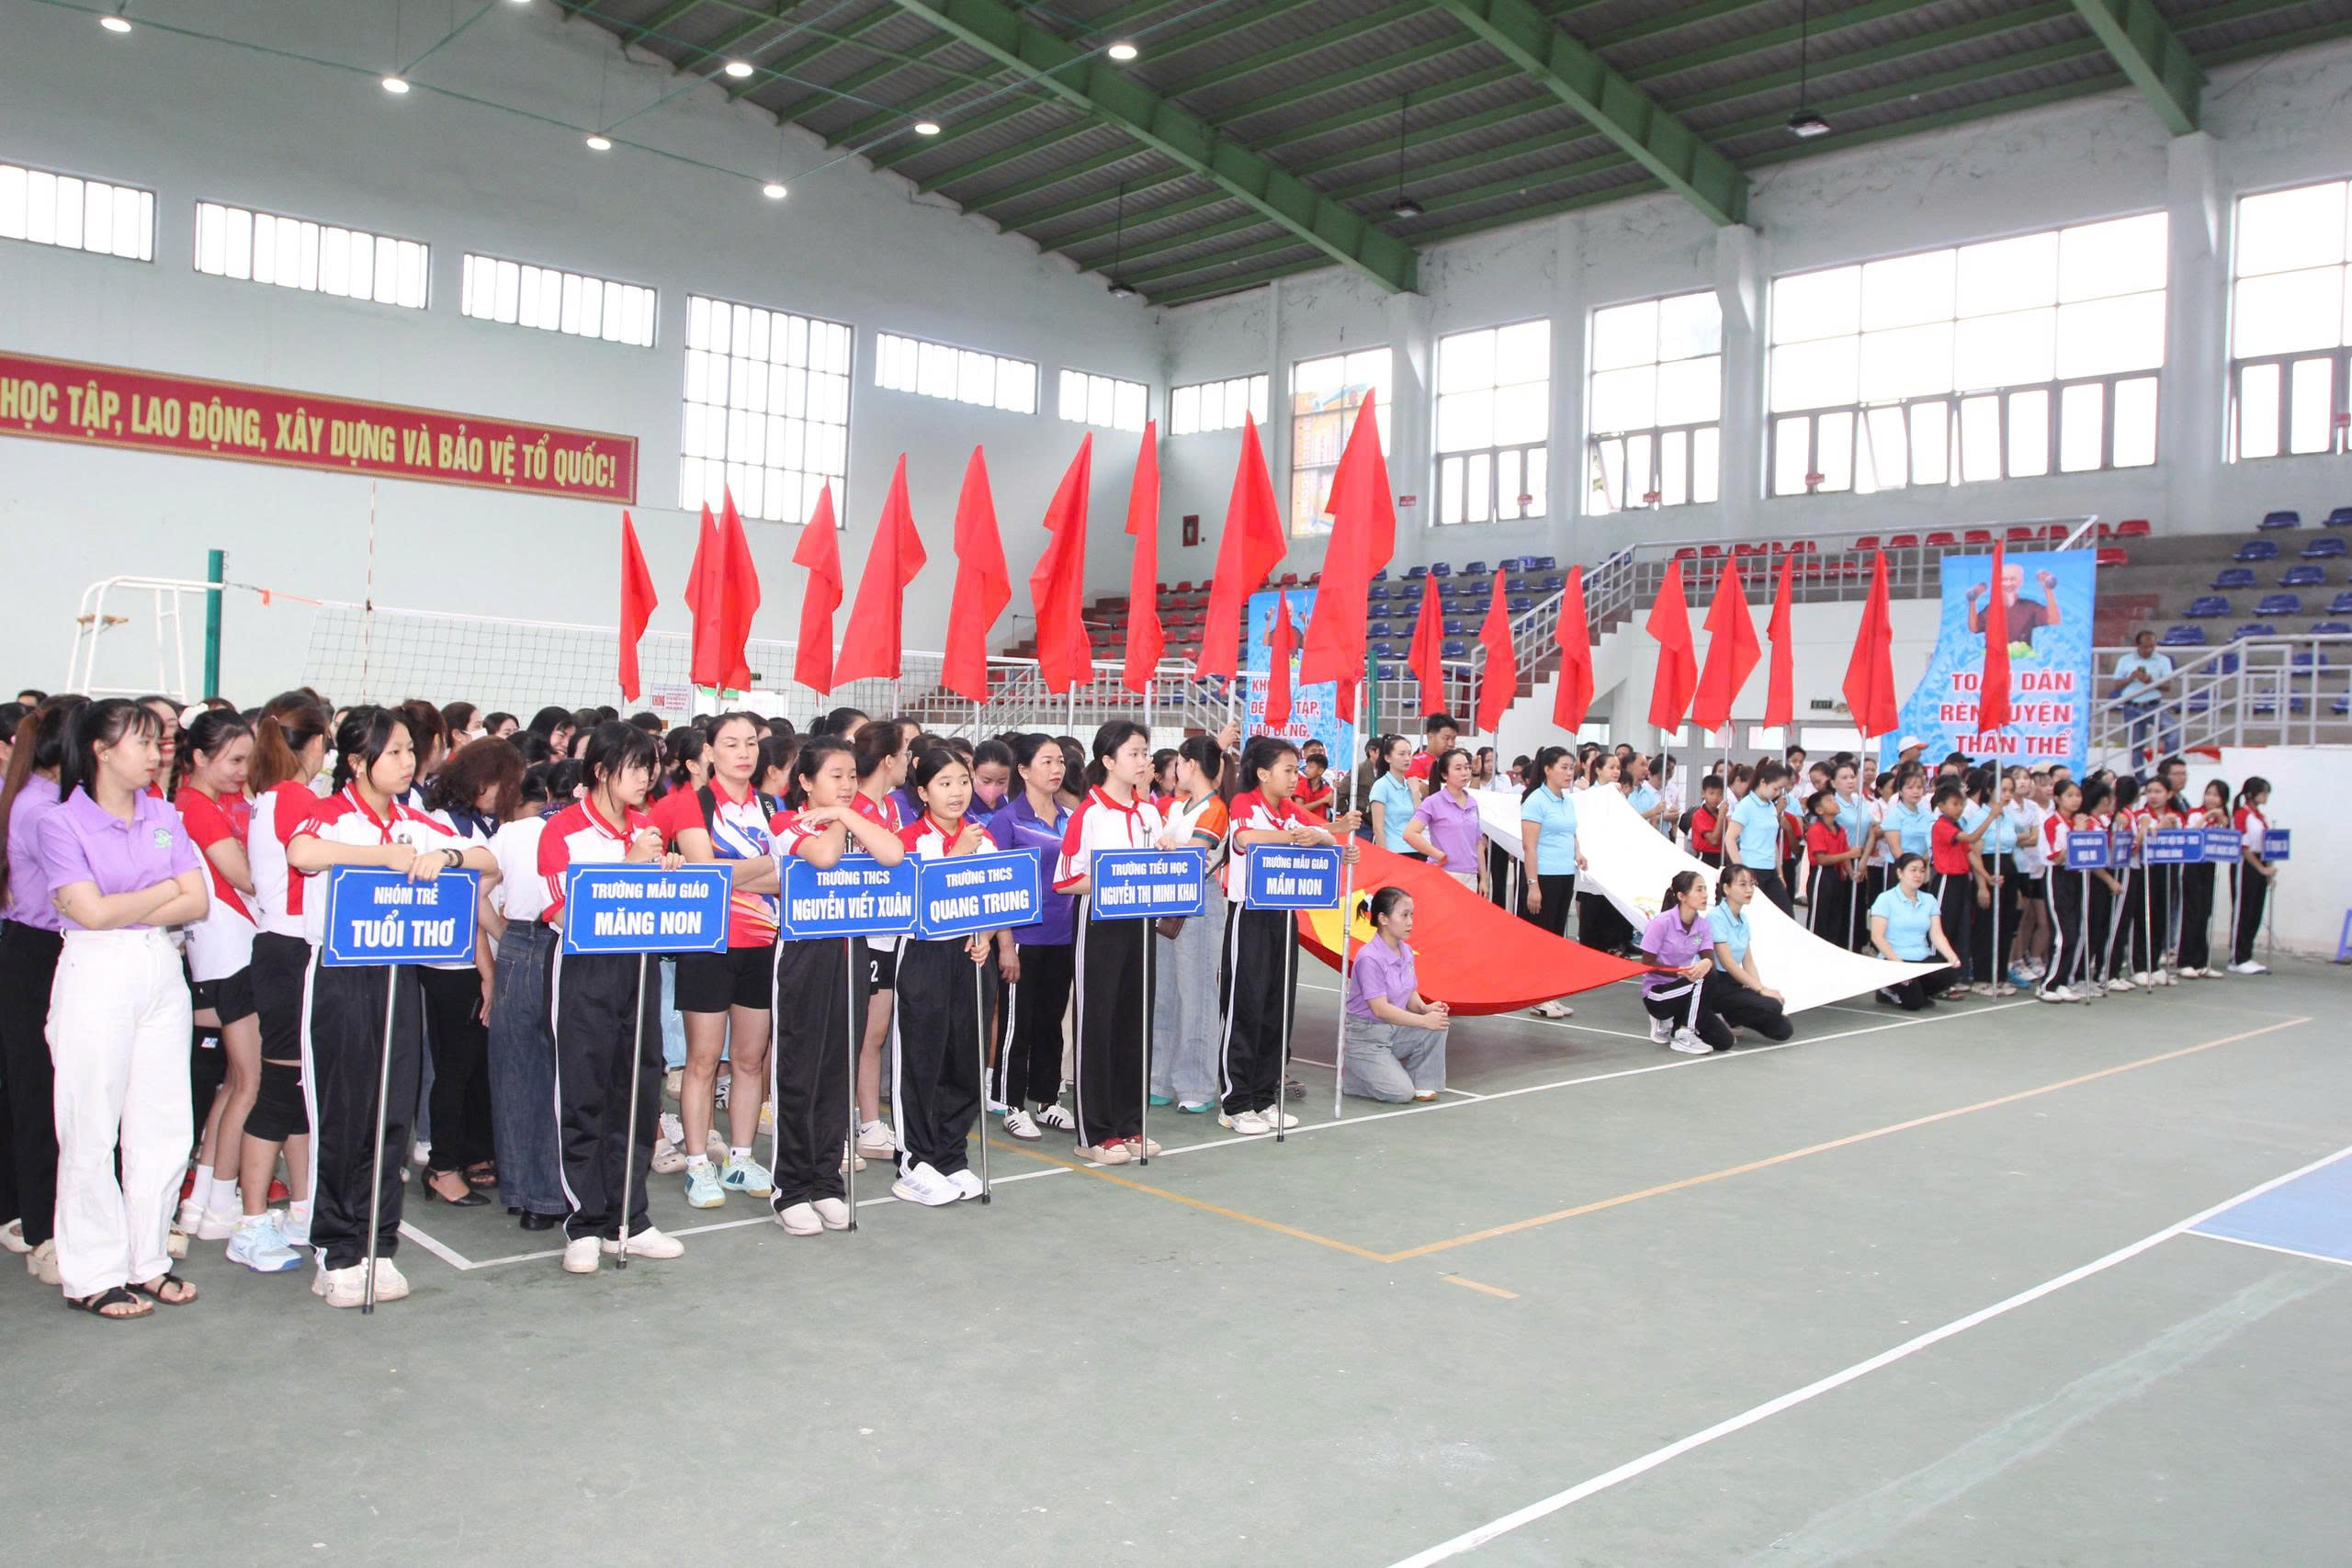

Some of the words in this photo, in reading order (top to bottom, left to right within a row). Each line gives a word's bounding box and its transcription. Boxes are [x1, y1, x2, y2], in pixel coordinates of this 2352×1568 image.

[1, 377, 59, 430] HỌC
[67, 380, 122, 436] TẬP,
[131, 394, 181, 438] LAO
[188, 396, 267, 453] ĐỘNG,
[275, 407, 324, 454] XÂY
[330, 419, 396, 467] DỰNG
[402, 423, 432, 467] VÀ
[438, 423, 483, 473] BẢO
[490, 434, 515, 484] VỆ
[522, 433, 549, 480] TỔ
[553, 441, 616, 489] QUỐC!
[2021, 669, 2071, 691] DÂN
[2009, 700, 2071, 727] UYỆN
[1956, 732, 2016, 754] THÂN
[1111, 861, 1147, 876] TRƯỜNG
[1148, 858, 1168, 874] TIỂU
[1170, 862, 1188, 876] HỌC
[1261, 854, 1292, 869] TRƯỜNG
[1293, 853, 1310, 869] MẪU
[1311, 856, 1329, 871] GIÁO
[591, 879, 643, 898] TRƯỜNG
[646, 877, 677, 898] MẪU
[679, 880, 709, 898] GIÁO
[816, 869, 860, 886] TRƯỜNG
[863, 870, 890, 885] THCS
[944, 869, 986, 887] TRƯỜNG
[987, 867, 1013, 883] THCS
[1266, 872, 1295, 896] MẦM
[1297, 878, 1323, 896] NON
[374, 883, 413, 905] NHÓM
[416, 882, 439, 905] TRẺ
[1101, 879, 1136, 906] NGUYỄN
[1136, 885, 1151, 908] THỊ
[1153, 884, 1176, 903] MINH
[1177, 883, 1197, 902] KHAI
[792, 890, 845, 921] NGUYỄN
[848, 890, 875, 919] VIẾT
[876, 891, 911, 918] XUÂN
[930, 895, 979, 923] QUANG
[982, 889, 1030, 914] TRUNG
[351, 909, 404, 948] TUỔI
[411, 918, 456, 947] THƠ
[594, 907, 655, 936] MĂNG
[660, 911, 702, 934] NON
[870, 960, 878, 982] 2
